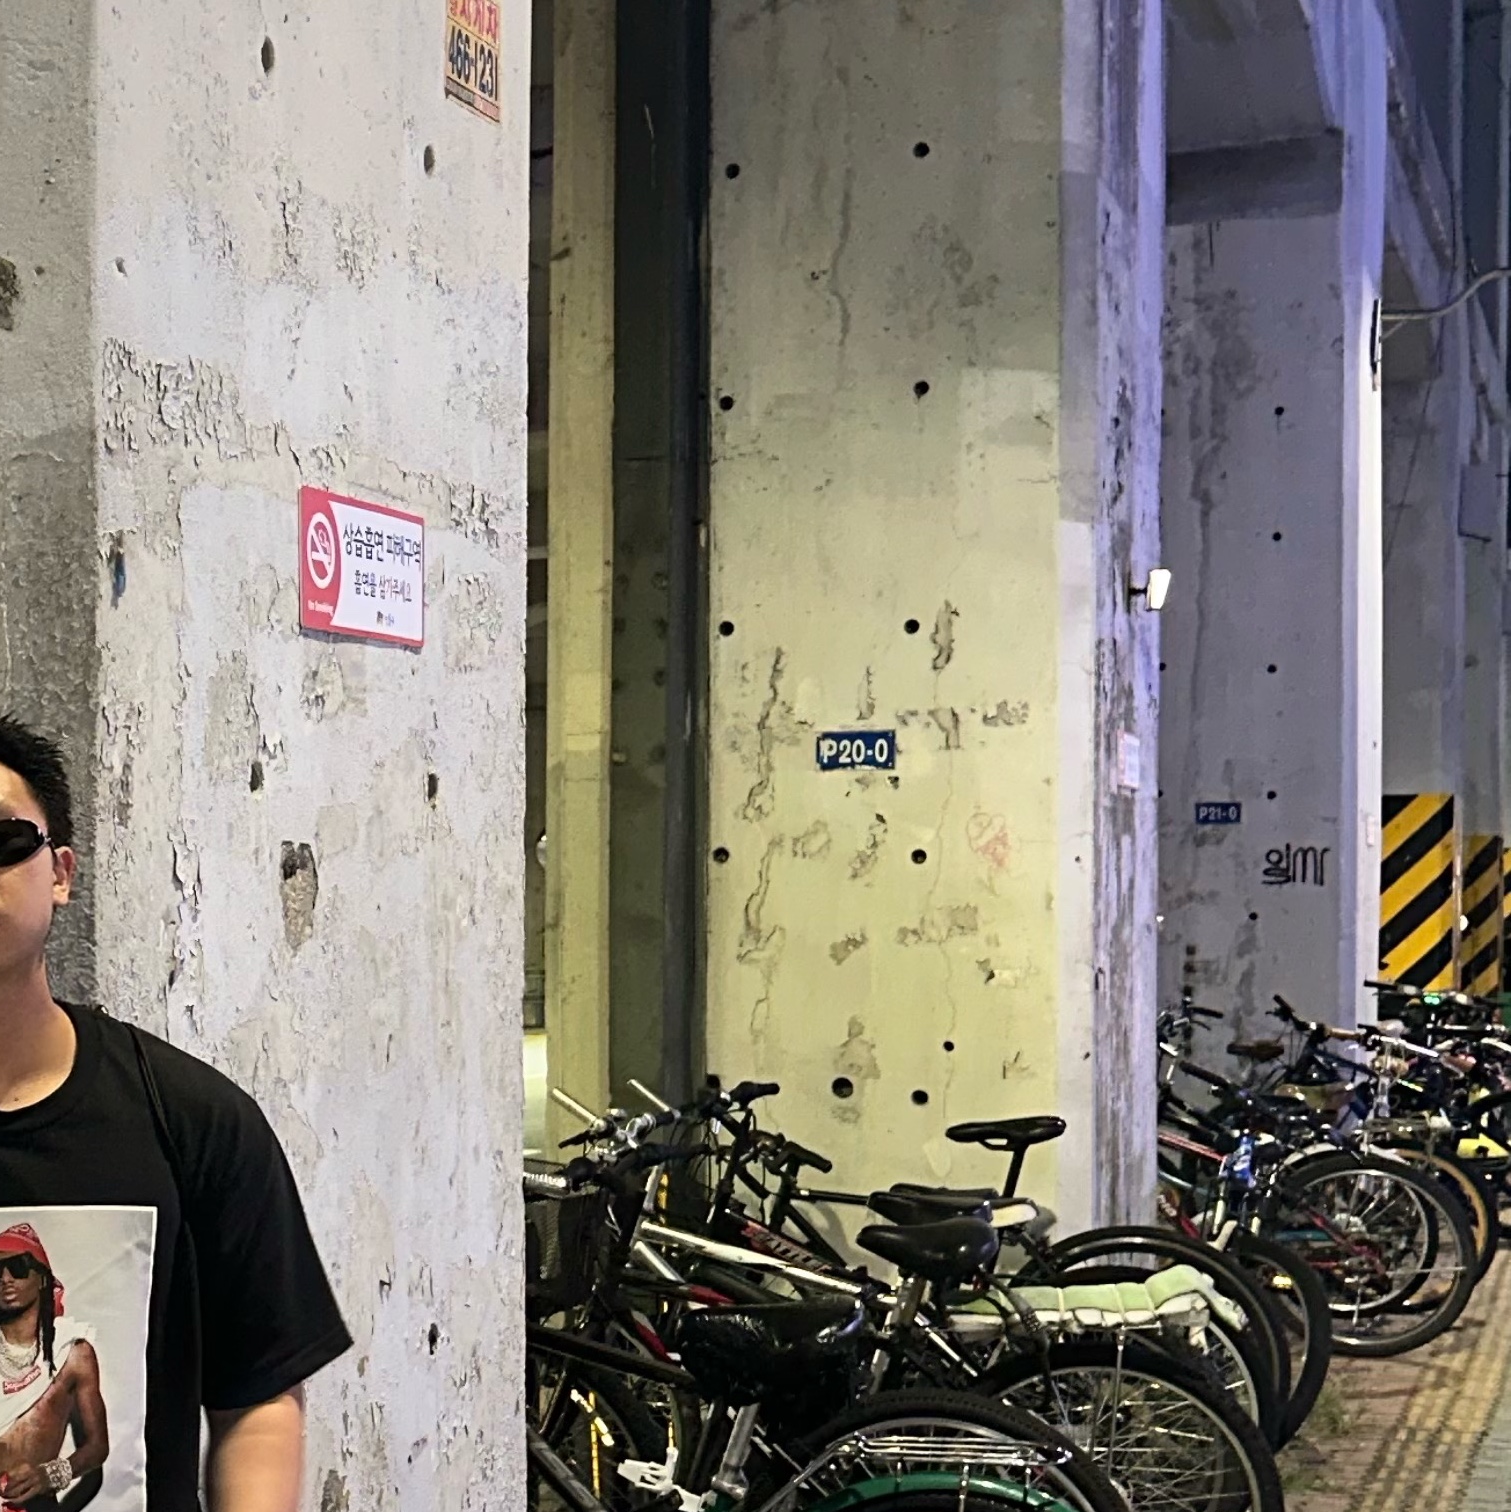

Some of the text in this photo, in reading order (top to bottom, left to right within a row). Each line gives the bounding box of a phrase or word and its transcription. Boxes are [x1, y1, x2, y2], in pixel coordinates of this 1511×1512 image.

[449, 26, 498, 101] 466-1231
[343, 522, 421, 572] 상습흡연 피해구역
[820, 738, 888, 764] P20-0
[1199, 806, 1237, 820] P21-0
